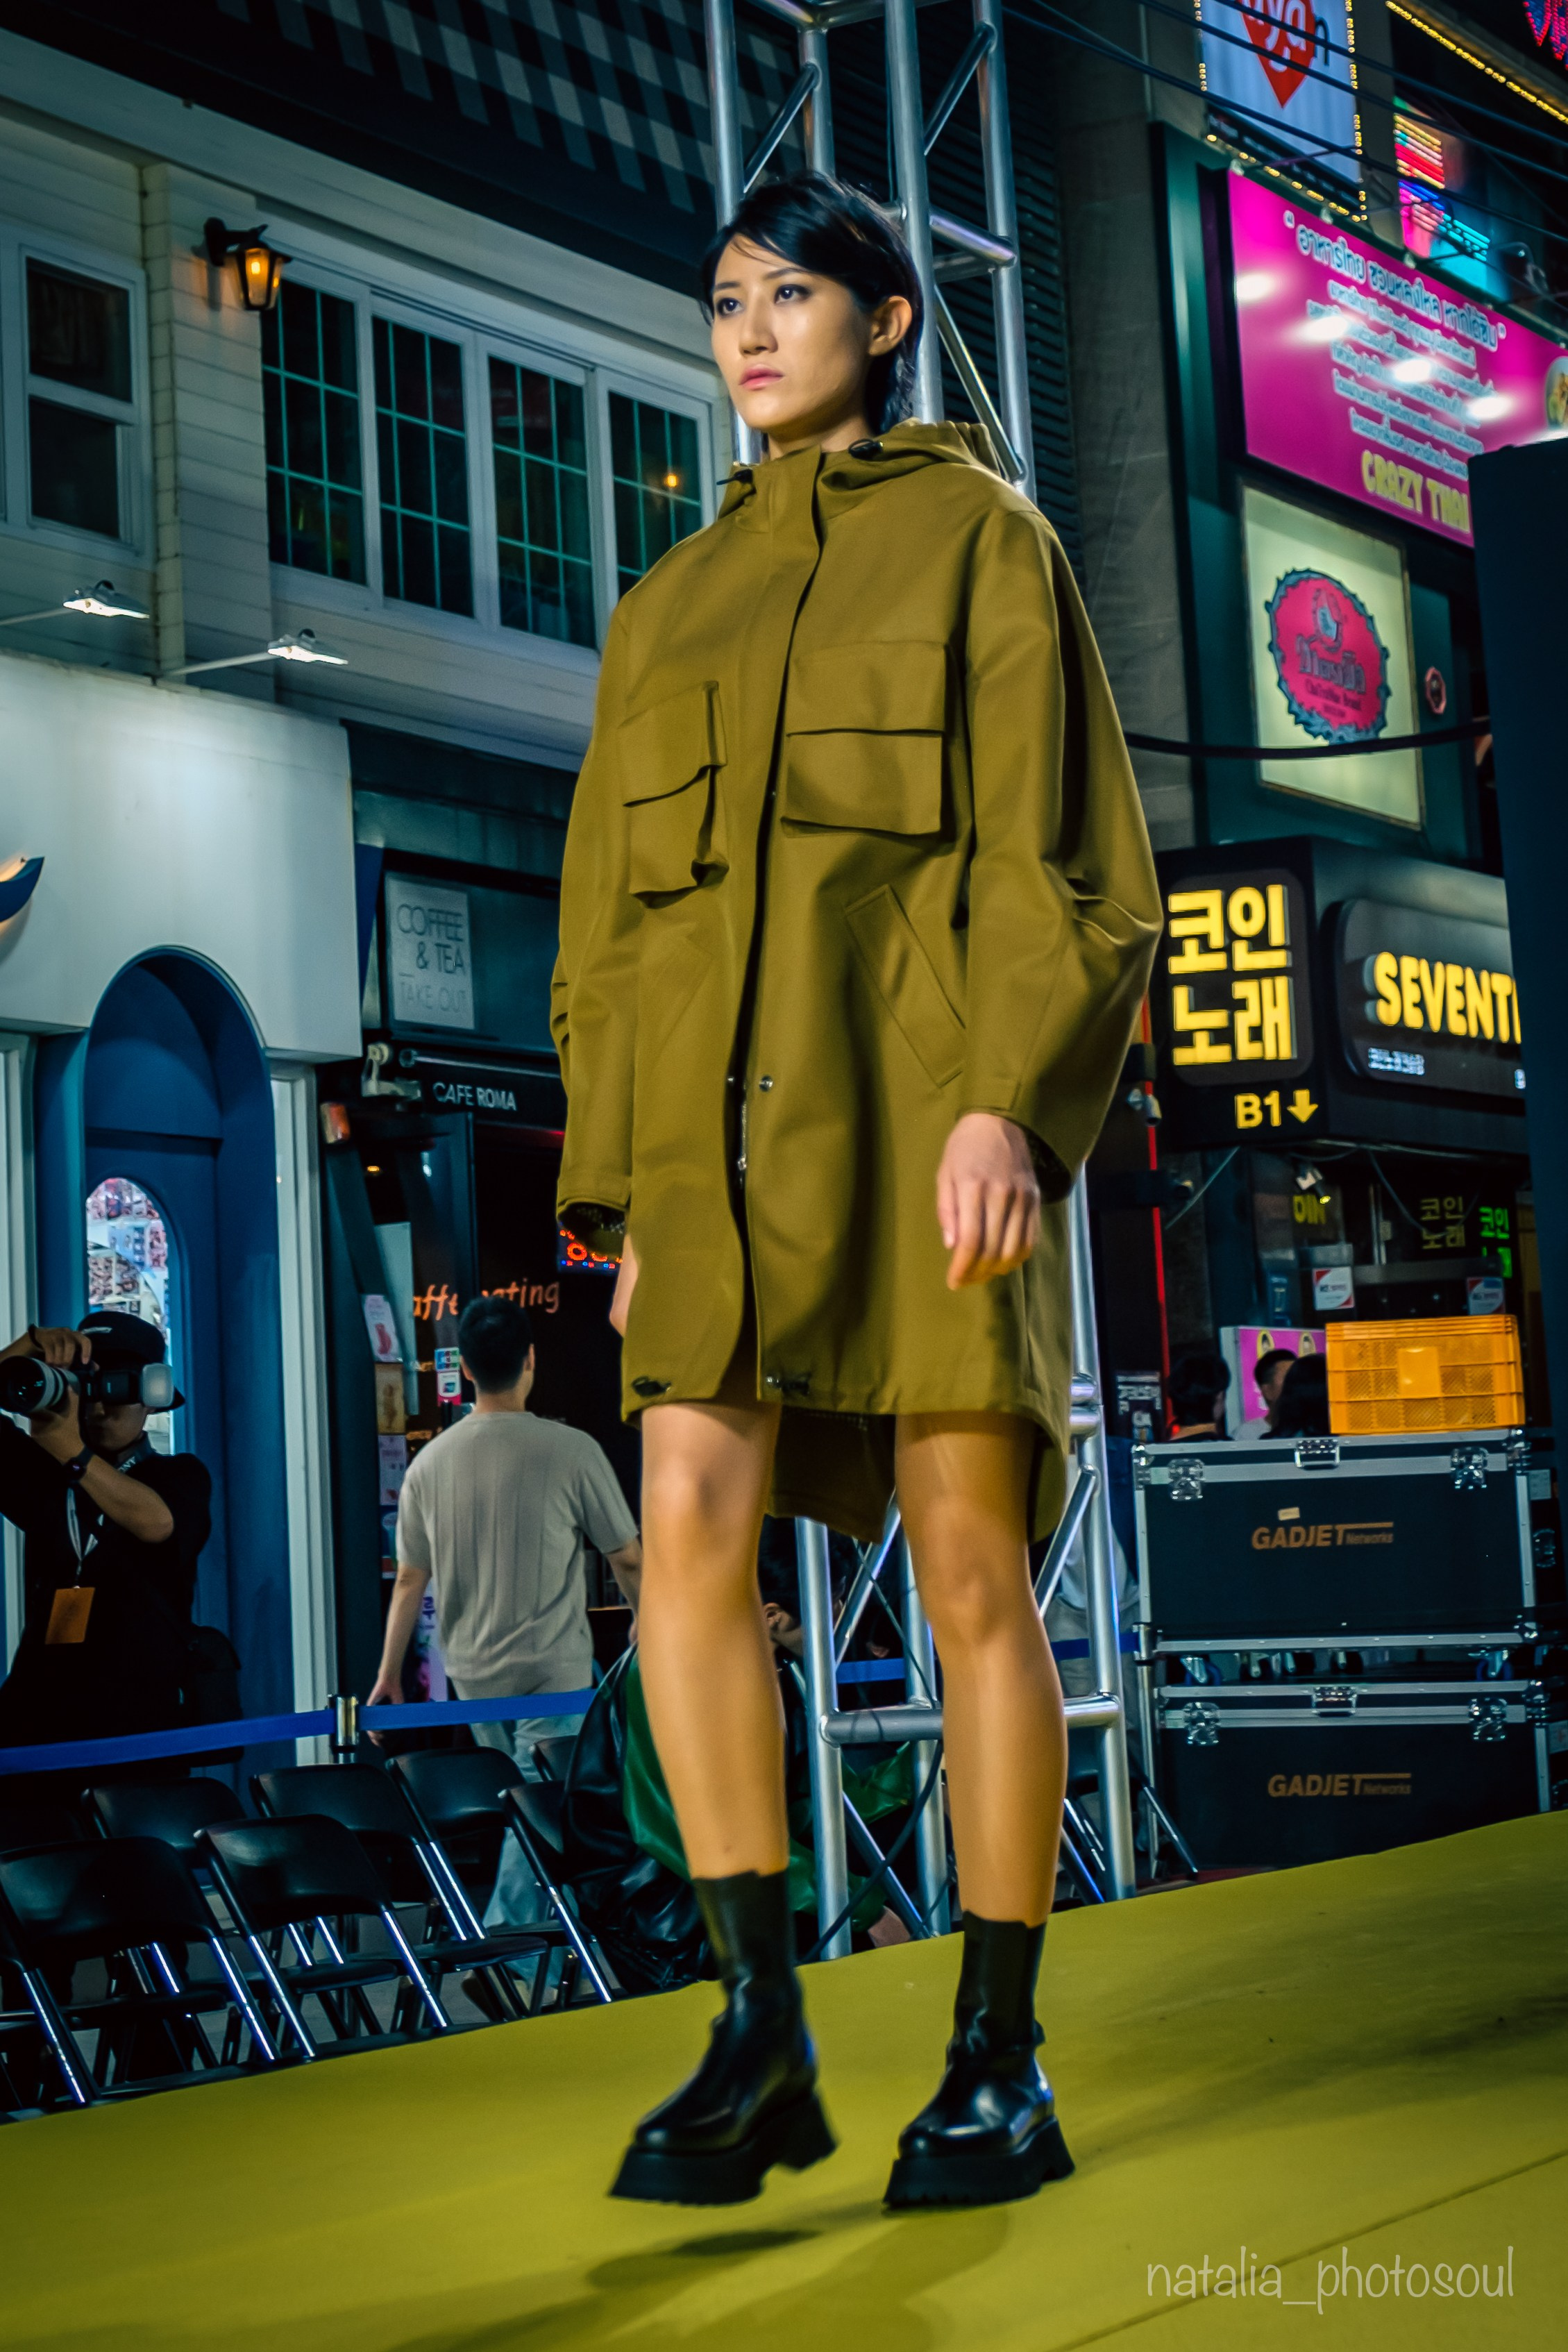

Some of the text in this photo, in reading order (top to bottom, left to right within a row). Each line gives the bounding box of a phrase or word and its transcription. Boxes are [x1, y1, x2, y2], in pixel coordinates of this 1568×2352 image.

[1361, 450, 1470, 534] CRAZY THAI
[397, 904, 464, 942] COFFEE
[1168, 884, 1286, 974] 코인
[416, 941, 466, 975] & TEA
[1374, 952, 1521, 1044] SEVENT
[1172, 976, 1292, 1066] 노래
[432, 1081, 518, 1111] CAFE ROMA
[1234, 1090, 1282, 1129] B1
[1420, 1195, 1467, 1221] 코인
[1251, 1523, 1345, 1549] GADJET
[1267, 1774, 1363, 1797] GADJET
